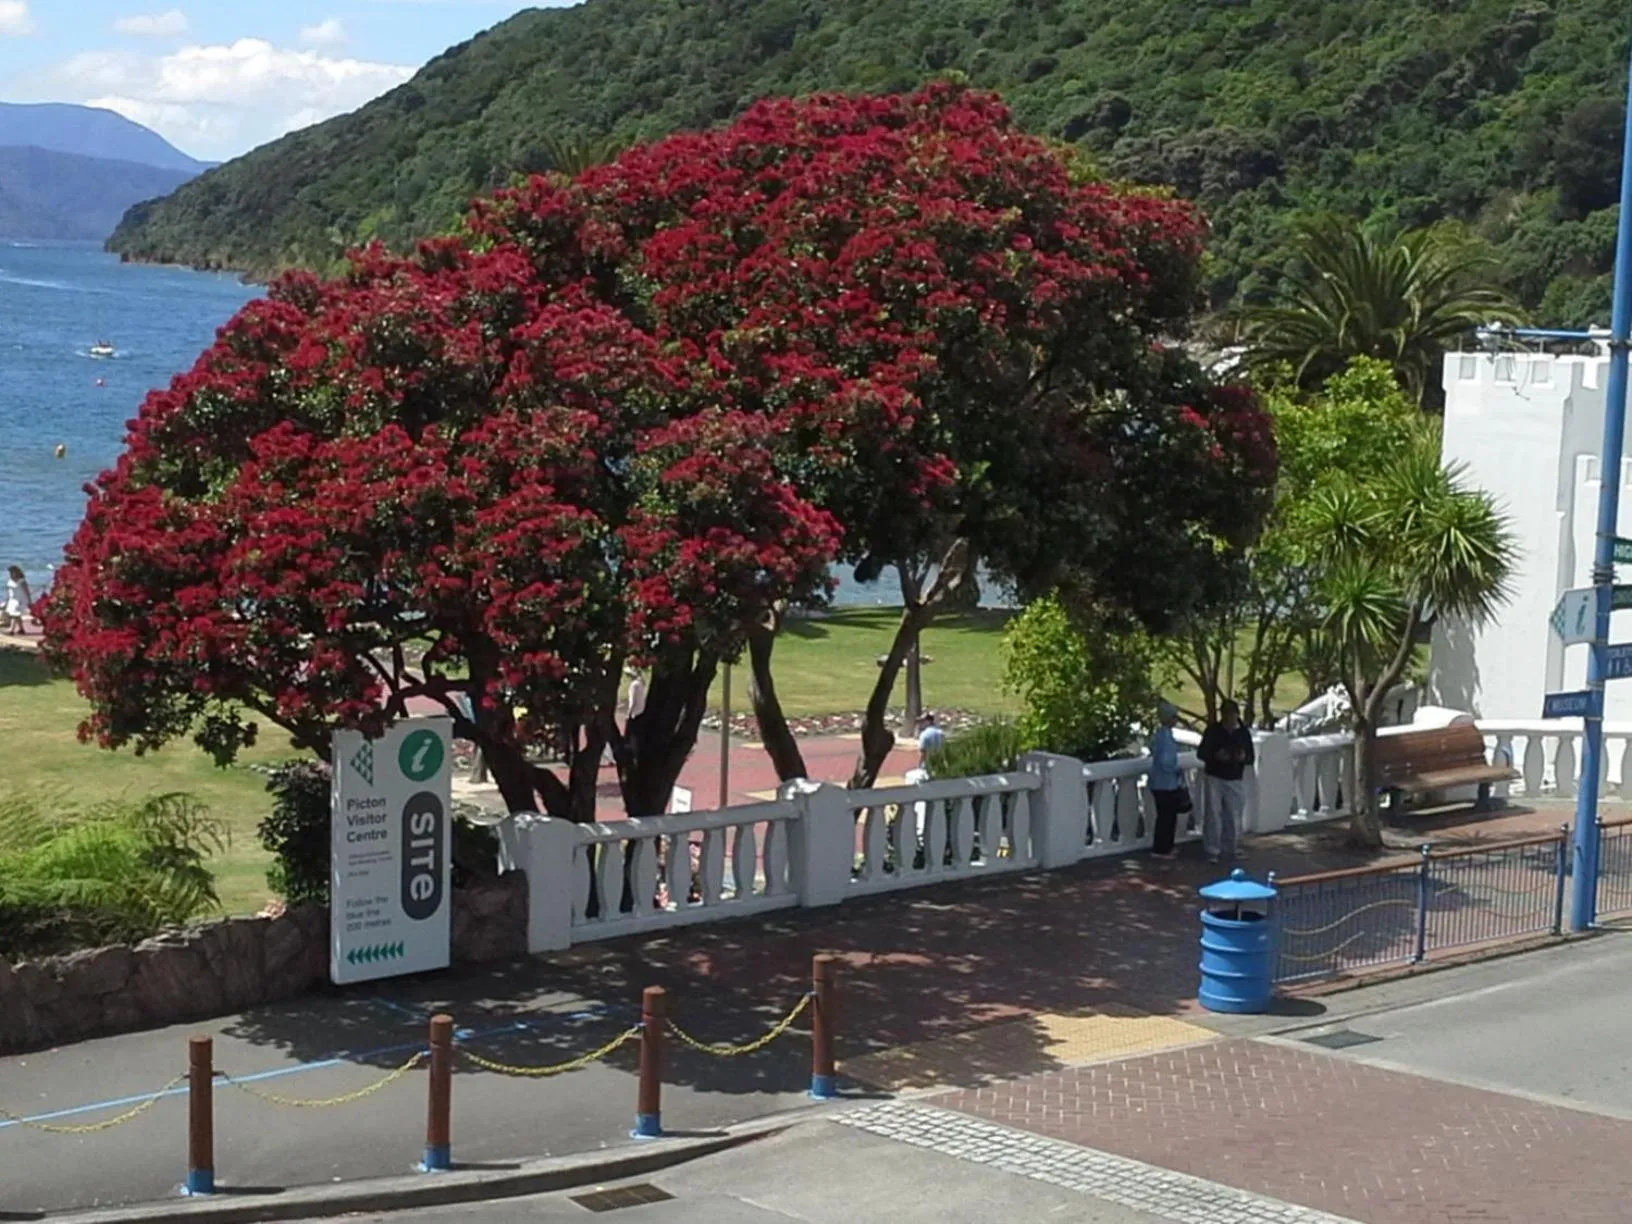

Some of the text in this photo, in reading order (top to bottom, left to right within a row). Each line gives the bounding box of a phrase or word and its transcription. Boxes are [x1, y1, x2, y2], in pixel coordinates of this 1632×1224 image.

[346, 798, 386, 810] Picton
[346, 814, 387, 826] Visitor
[346, 830, 387, 842] Centre
[346, 899, 372, 908] Follow
